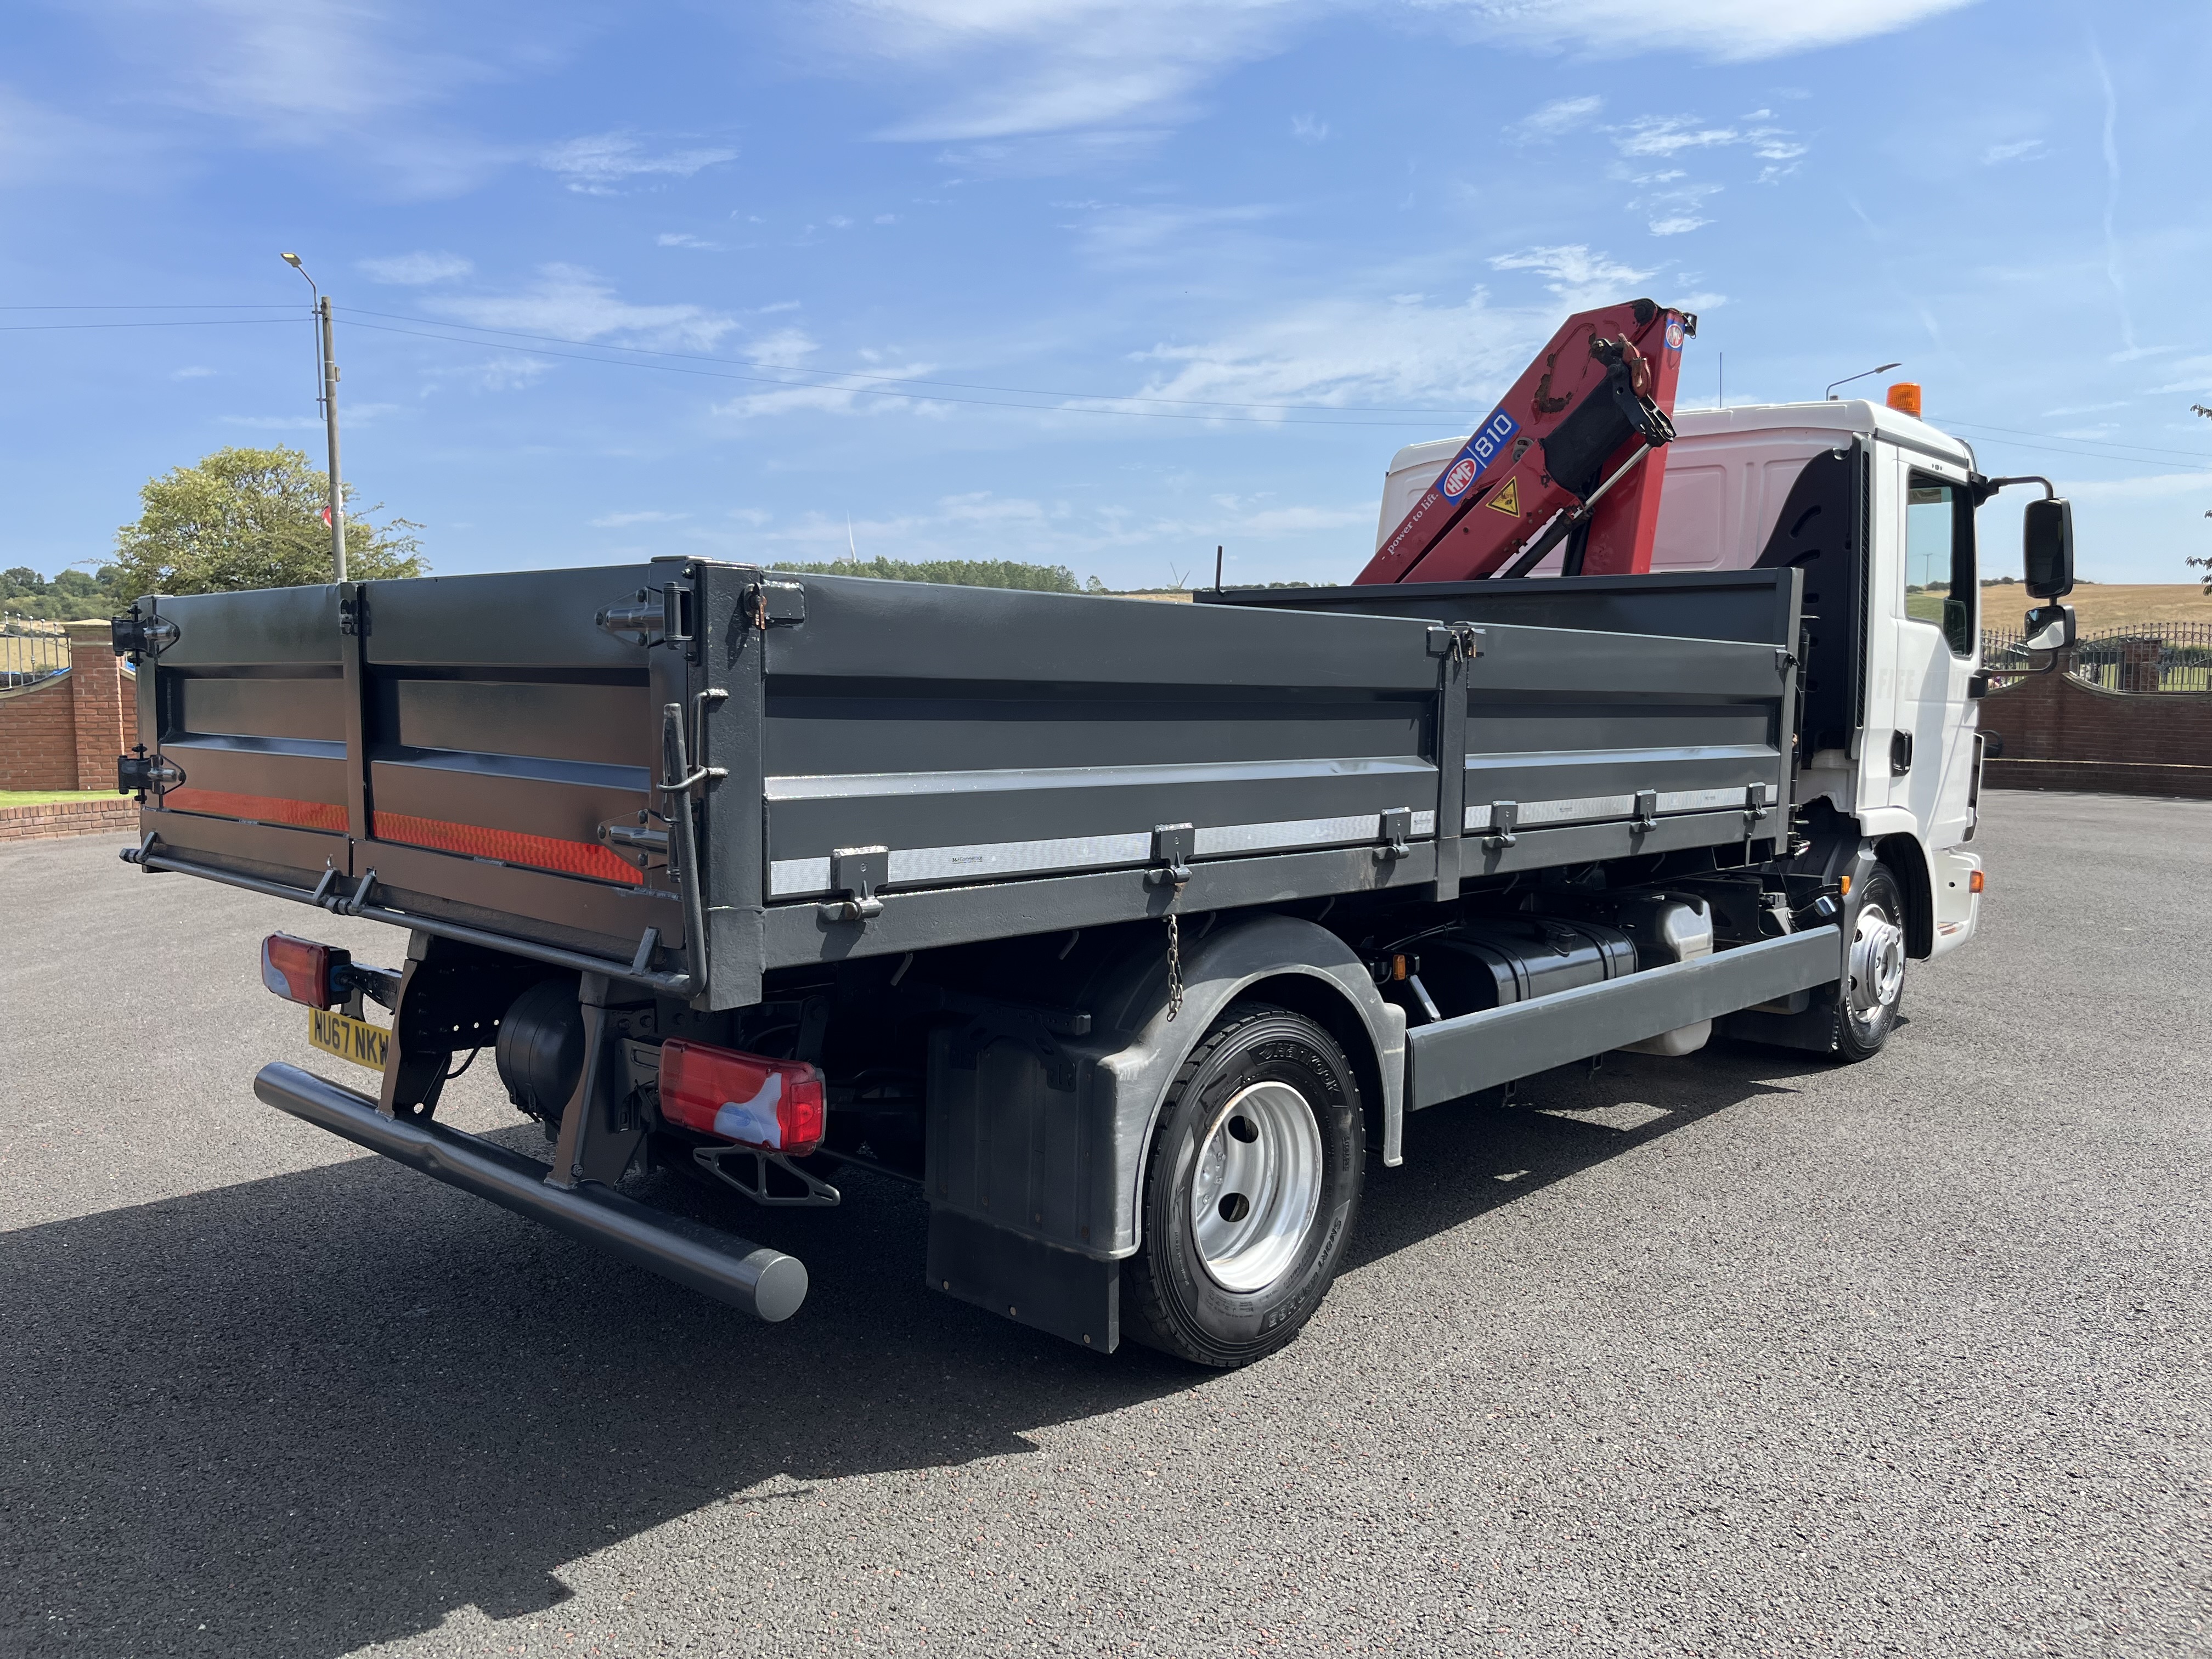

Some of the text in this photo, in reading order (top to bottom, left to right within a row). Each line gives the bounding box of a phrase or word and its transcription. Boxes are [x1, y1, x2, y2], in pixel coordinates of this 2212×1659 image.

[1668, 326, 1681, 345] HMF
[1446, 414, 1512, 493] HMF 810
[1387, 521, 1413, 555] power
[1412, 511, 1424, 522] to
[1421, 493, 1439, 511] lift.
[314, 1010, 350, 1053] NU67
